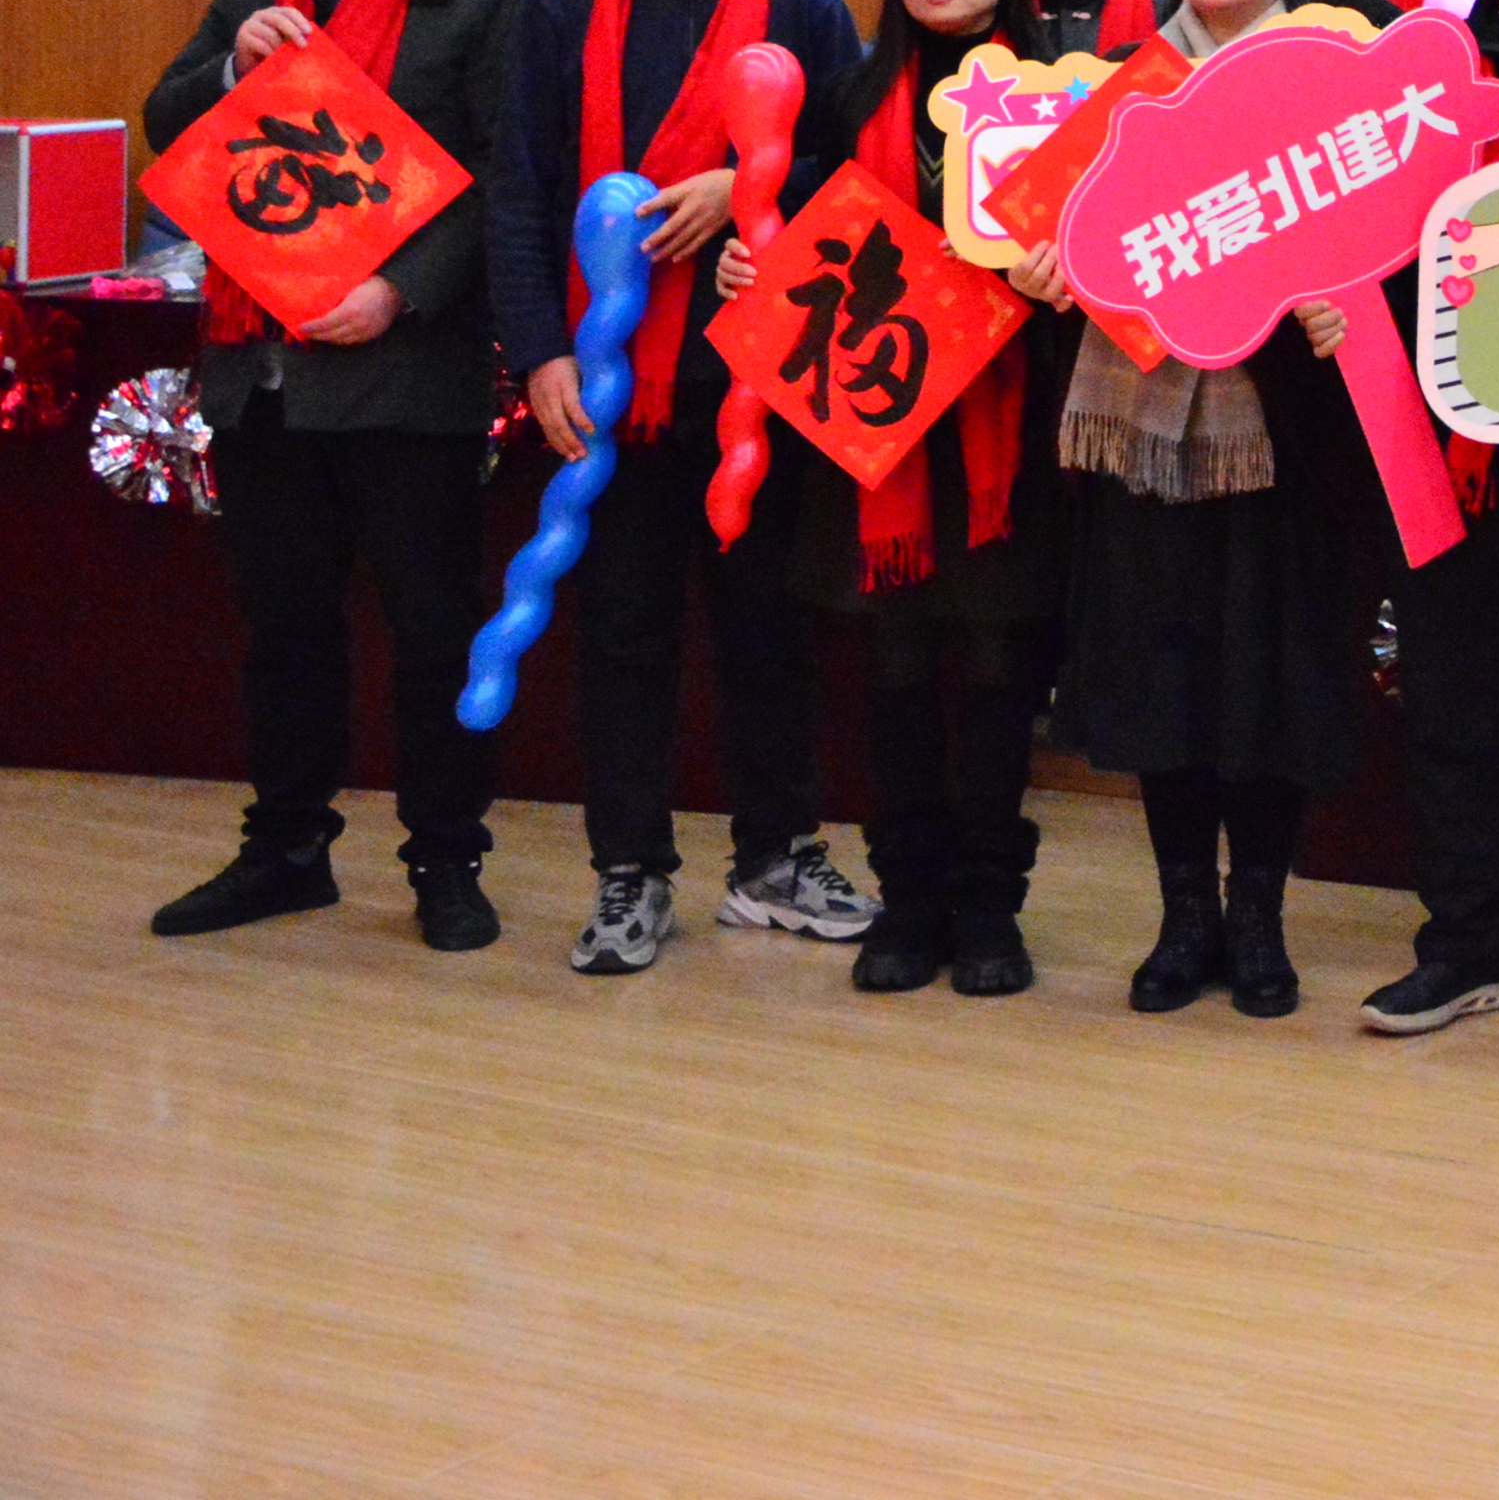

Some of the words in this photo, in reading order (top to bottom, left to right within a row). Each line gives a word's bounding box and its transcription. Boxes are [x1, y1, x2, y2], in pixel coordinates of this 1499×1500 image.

[1120, 80, 1460, 300] 我爱北建大
[779, 218, 931, 428] 福
